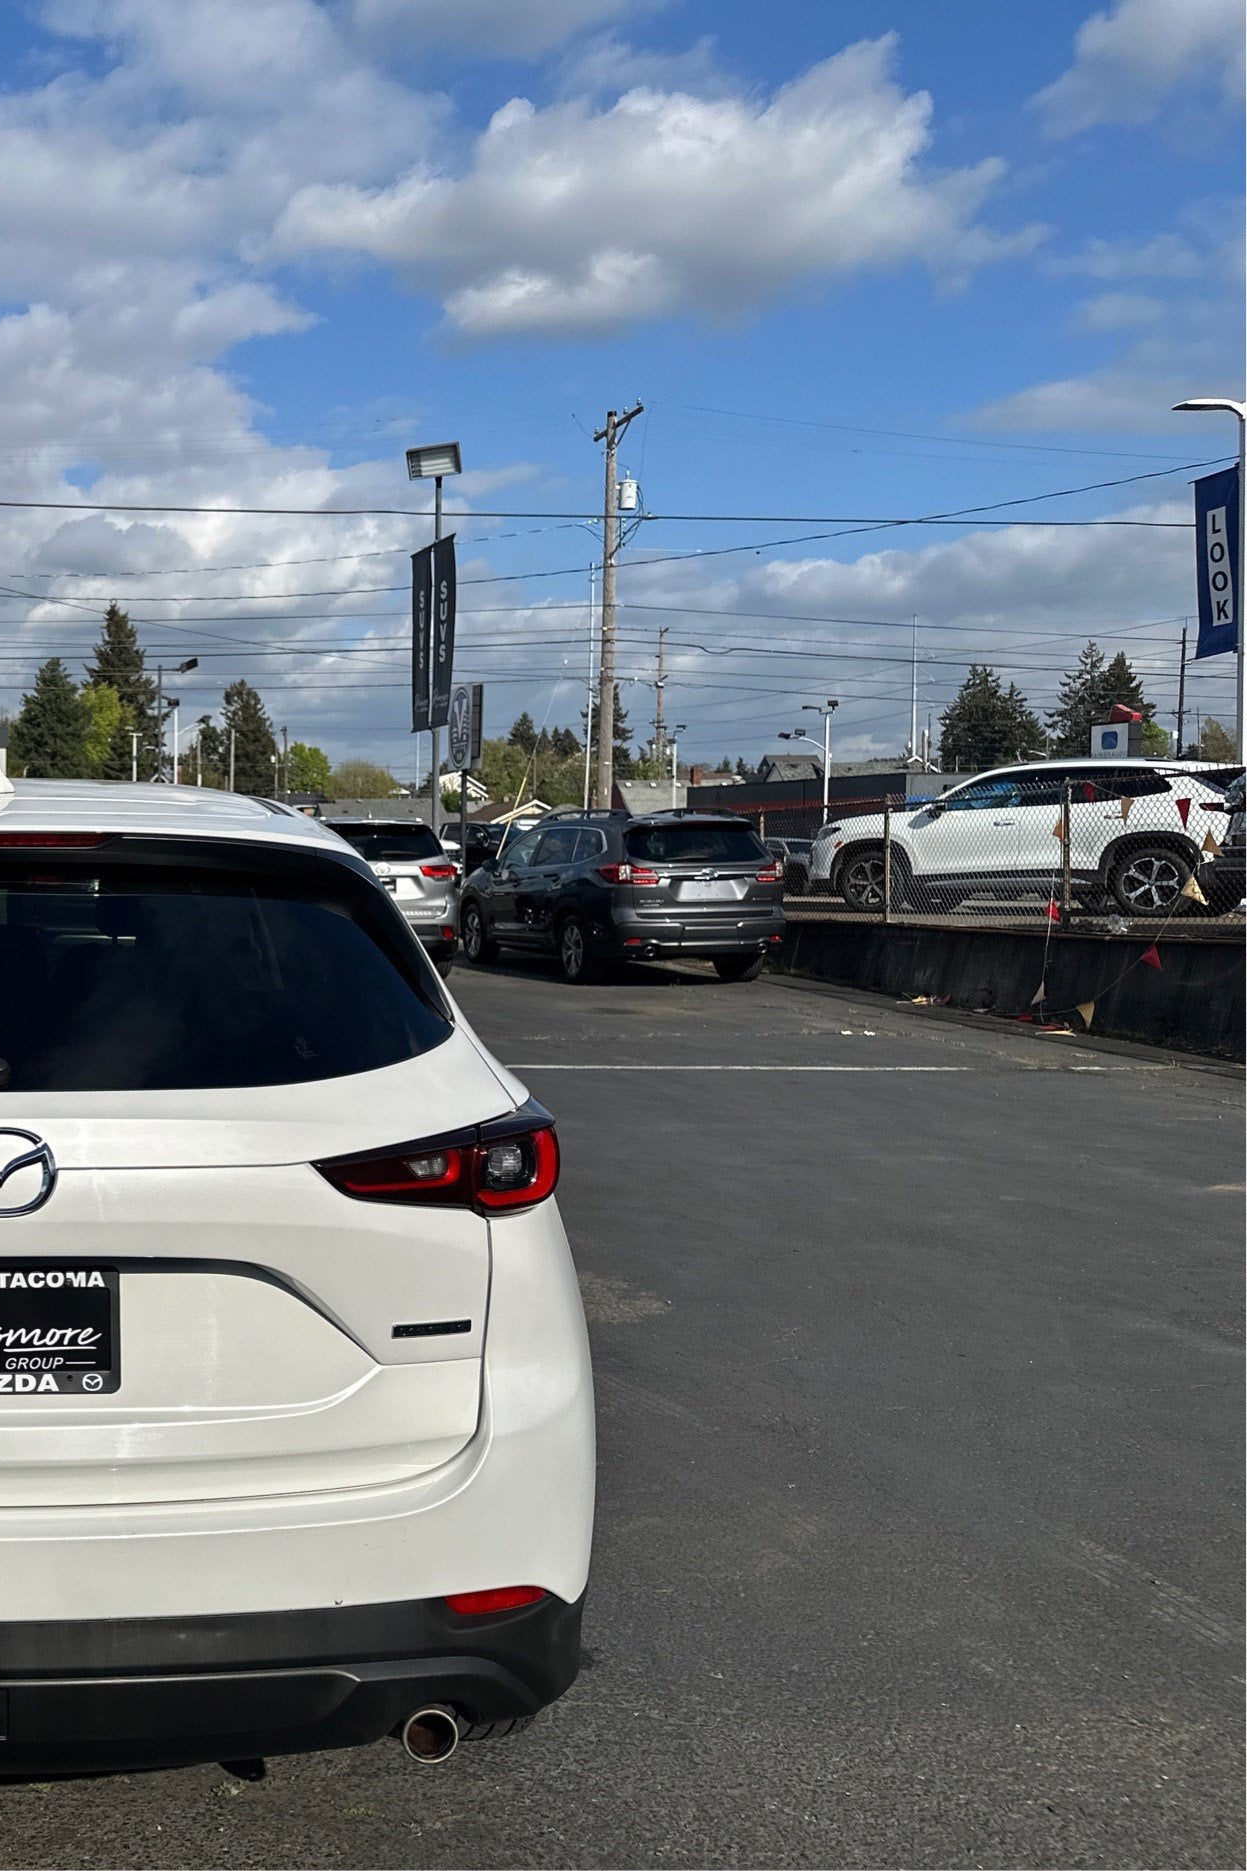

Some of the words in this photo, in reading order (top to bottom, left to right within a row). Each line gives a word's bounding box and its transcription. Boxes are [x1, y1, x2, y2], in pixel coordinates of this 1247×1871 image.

[1209, 514, 1229, 621] LOOK
[438, 580, 448, 663] SUVS
[5, 1357, 64, 1370] GROUP
